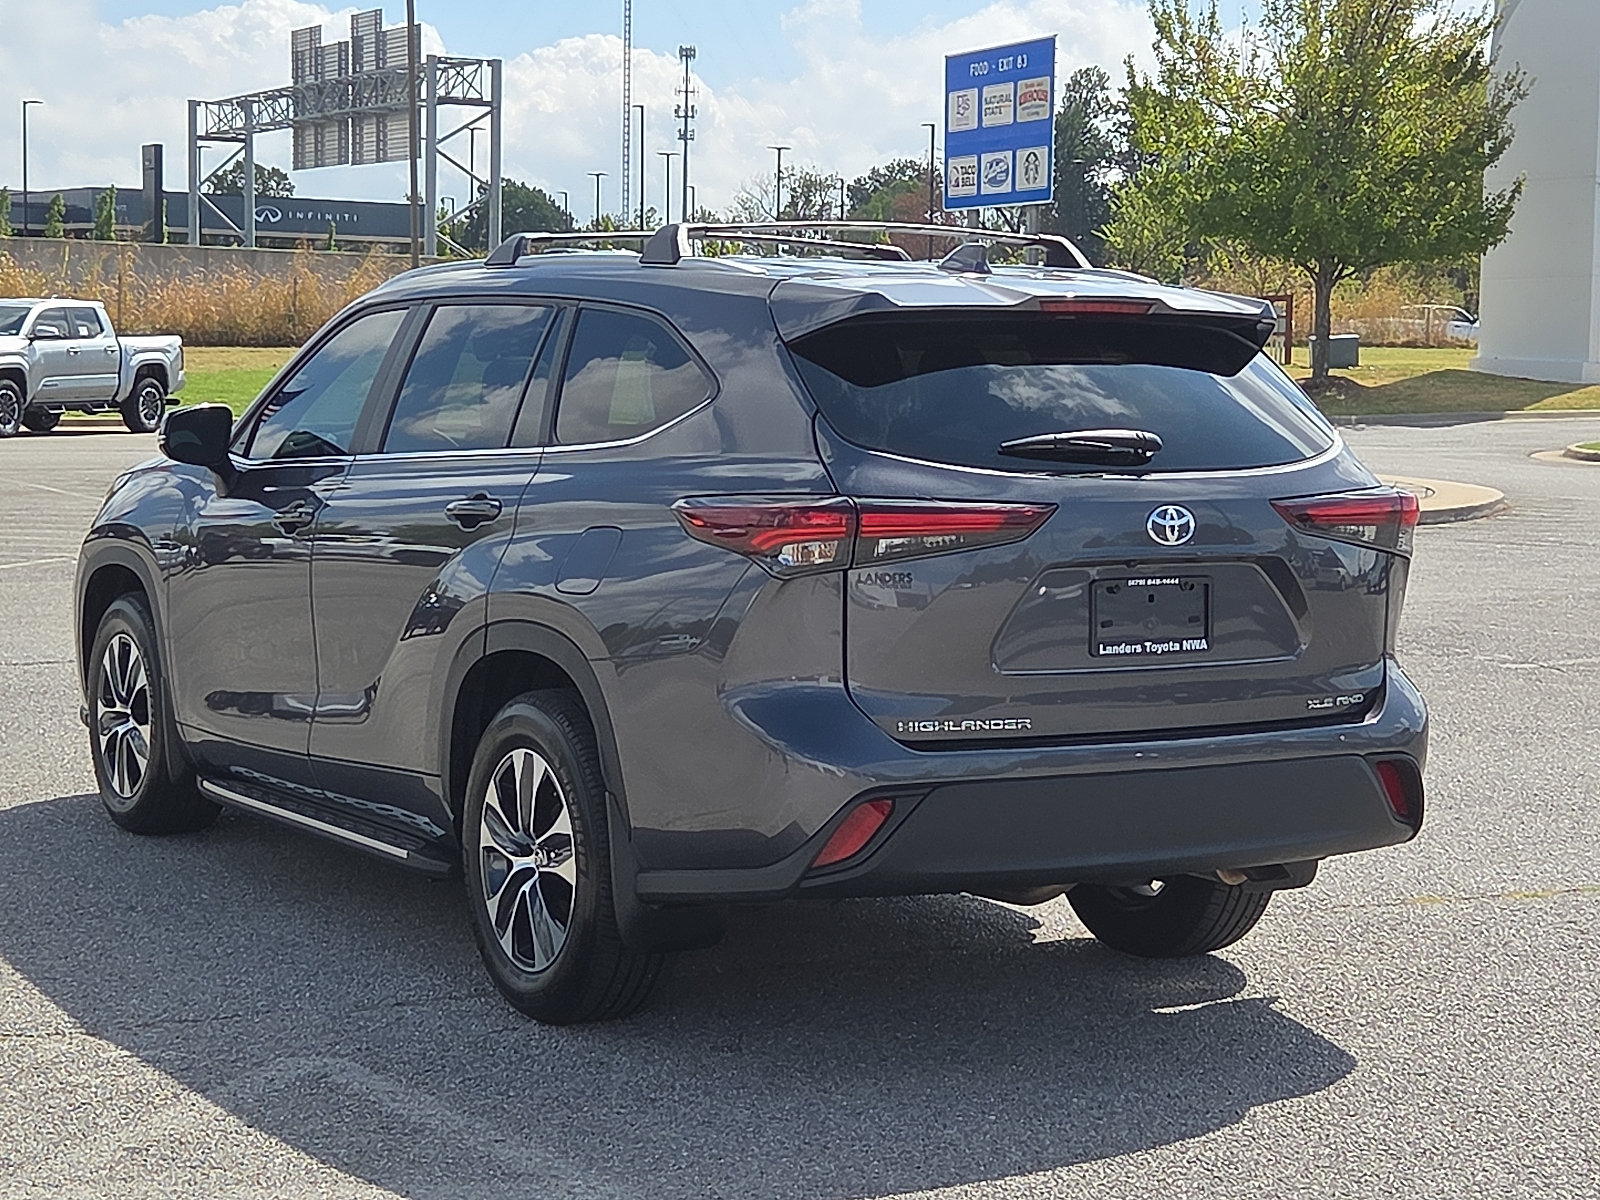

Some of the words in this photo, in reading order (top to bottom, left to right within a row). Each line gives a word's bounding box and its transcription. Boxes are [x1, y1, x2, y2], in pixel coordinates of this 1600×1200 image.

[969, 61, 989, 77] FOOD
[998, 57, 1014, 72] EXIT
[1016, 54, 1028, 69] 83
[984, 93, 1013, 105] NATURAL
[984, 105, 1003, 117] STATE
[960, 164, 976, 176] TACO
[961, 176, 976, 188] BELL
[288, 211, 359, 222] INFINITI
[856, 572, 913, 585] LANDERS
[1099, 643, 1142, 655] Landers
[1144, 640, 1180, 654] Toyota
[1182, 638, 1208, 651] NWA
[1307, 697, 1334, 710] XLE
[897, 718, 1032, 732] HIGHLANDER
